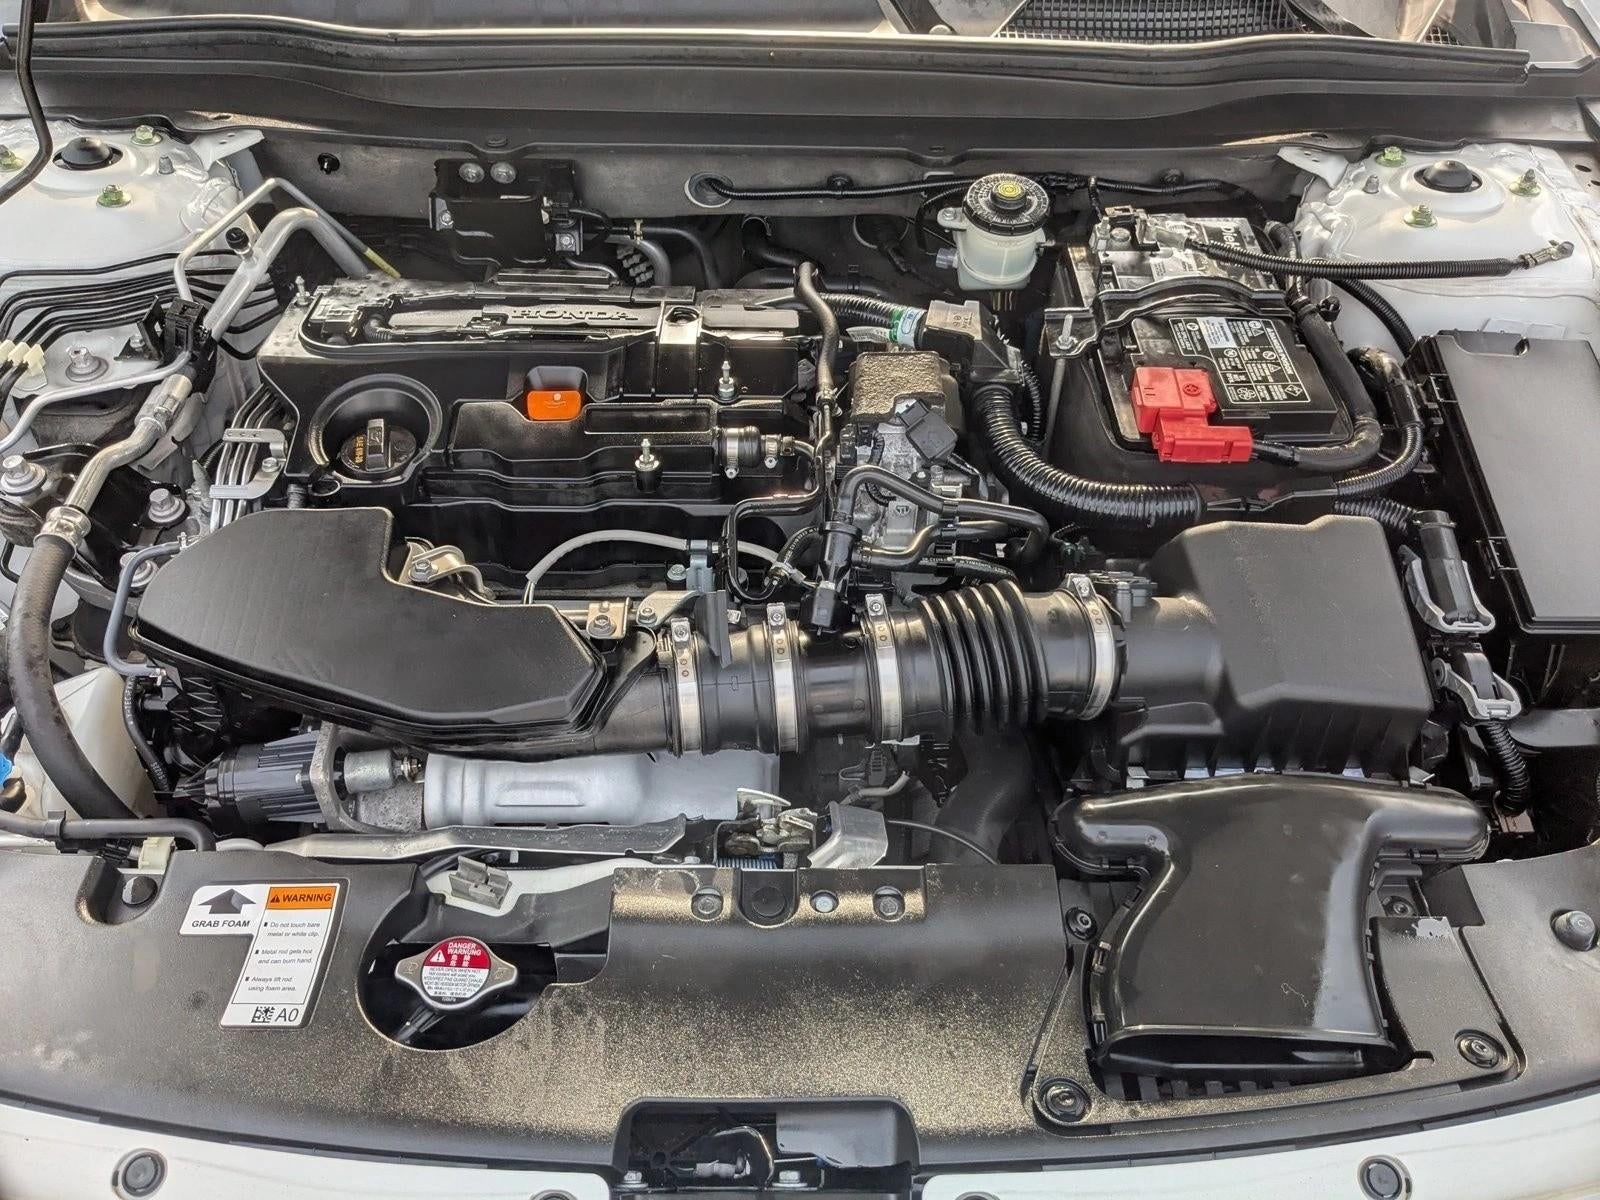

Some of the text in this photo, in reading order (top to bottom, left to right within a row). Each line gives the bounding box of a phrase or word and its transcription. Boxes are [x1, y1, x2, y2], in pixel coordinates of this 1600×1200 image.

[511, 309, 639, 321] HONDA
[282, 893, 332, 903] WARNING
[191, 920, 251, 928] GRAB FOAM
[447, 948, 481, 956] WARNING
[274, 1008, 299, 1022] A0
